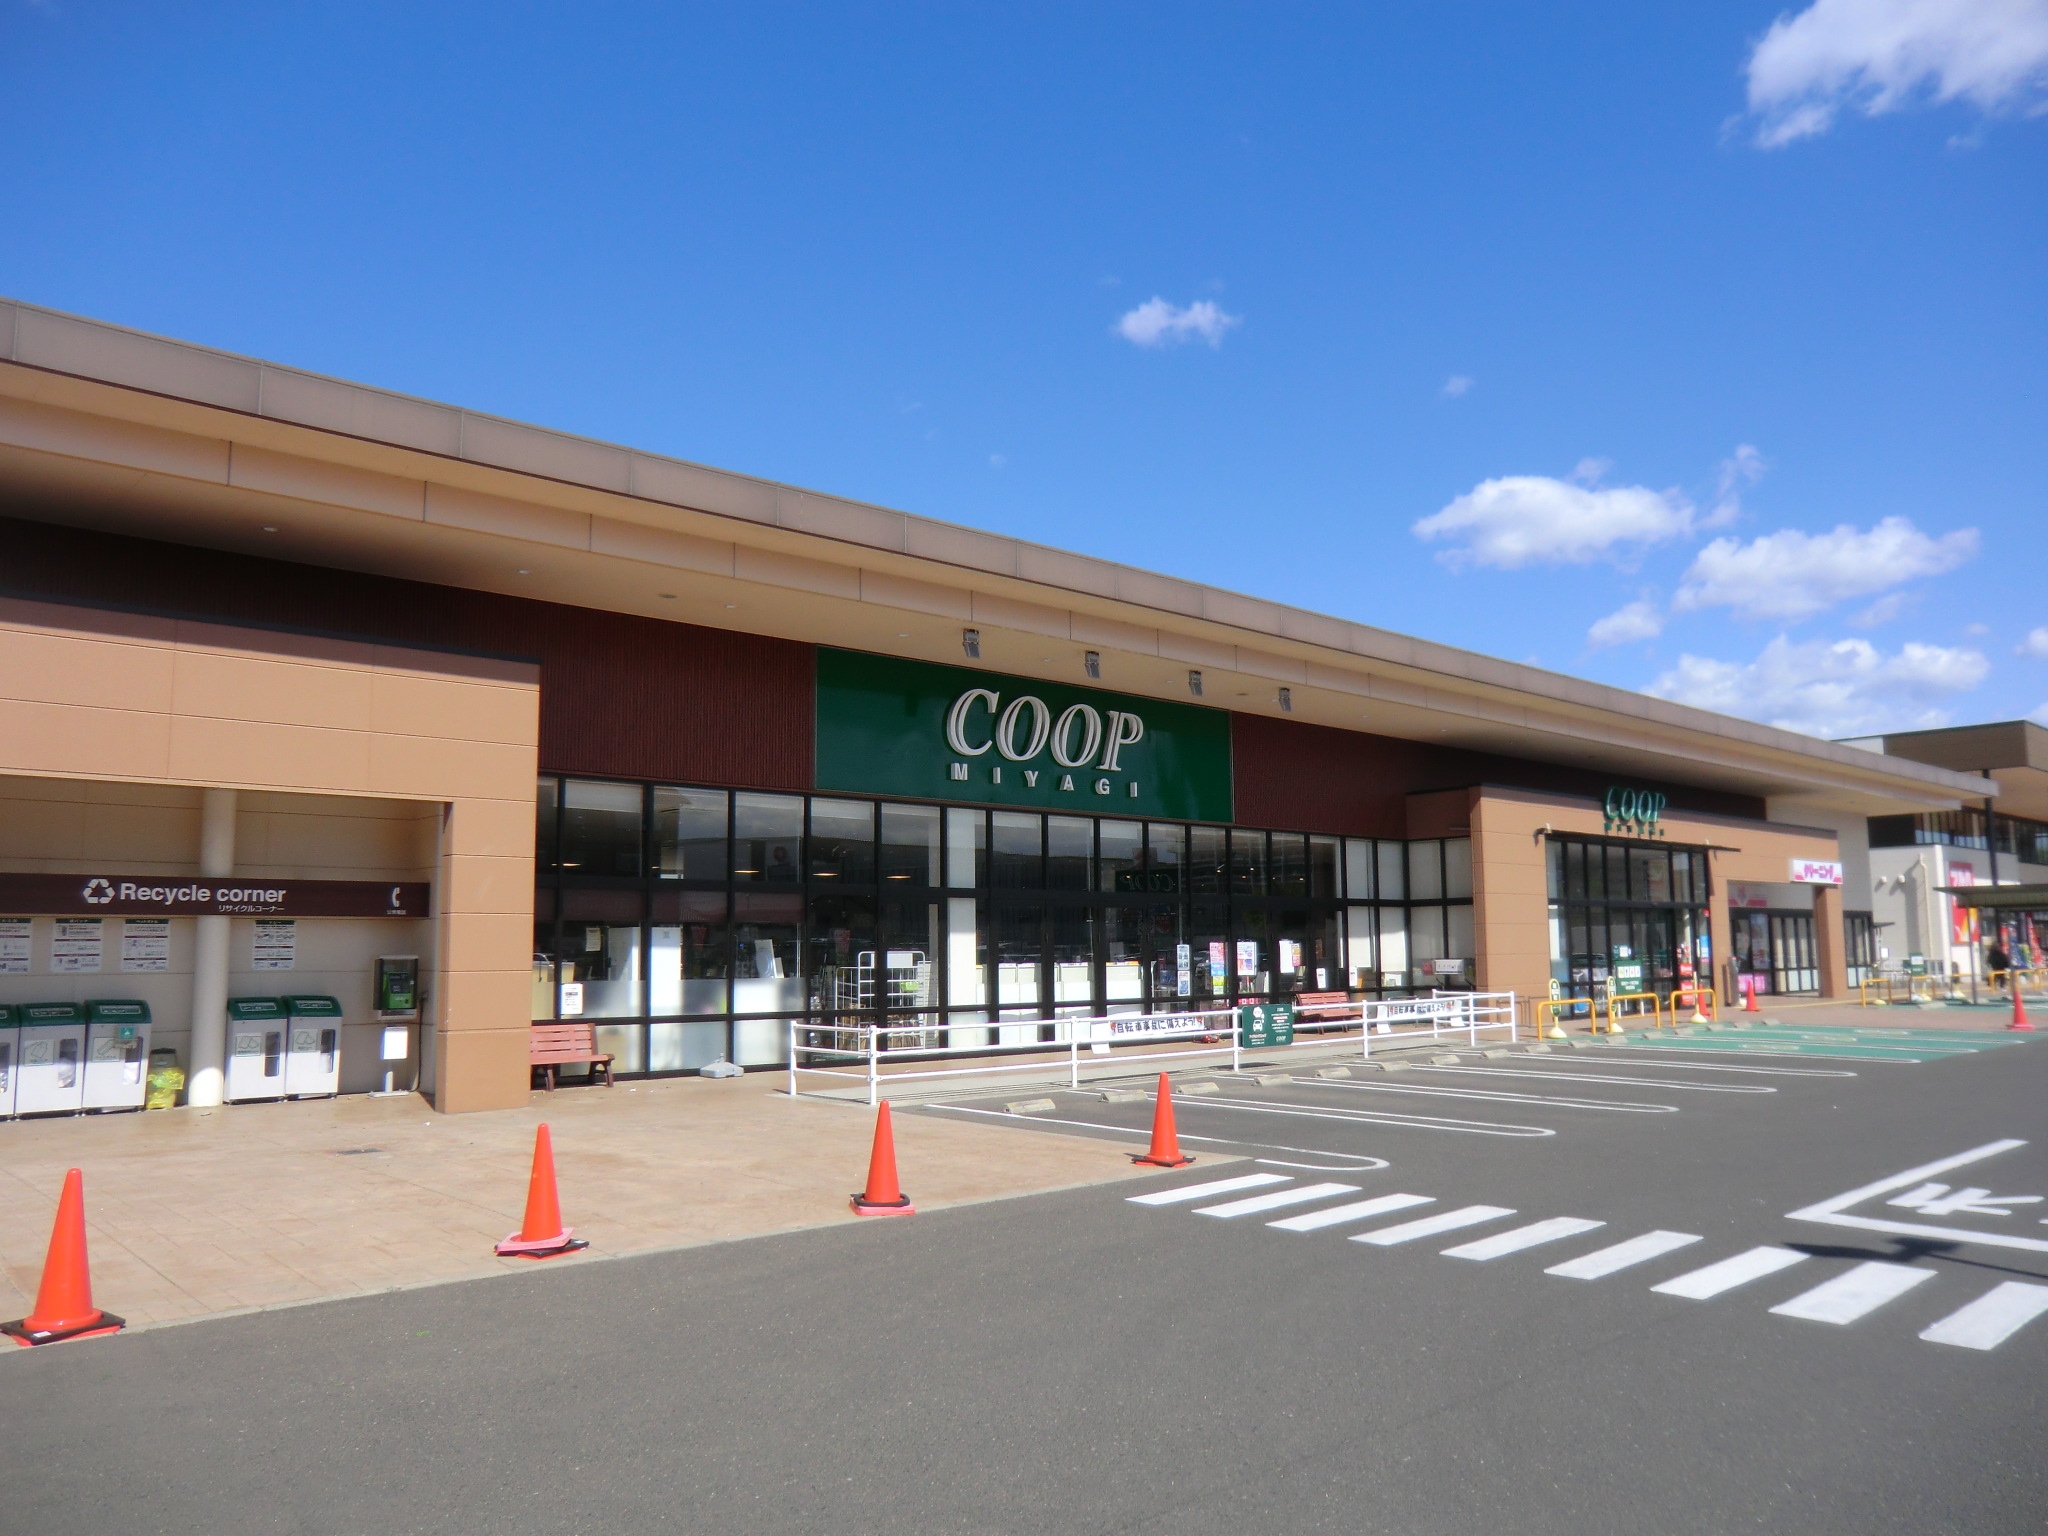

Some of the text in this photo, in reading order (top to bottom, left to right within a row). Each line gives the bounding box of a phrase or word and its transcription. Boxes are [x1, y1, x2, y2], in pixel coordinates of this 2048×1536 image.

[946, 688, 1144, 771] COOP
[950, 762, 1139, 798] MIYAGI
[1605, 786, 1666, 823] COOP
[120, 883, 287, 905] Recycle corner
[218, 904, 285, 913] リサイクルコーナー
